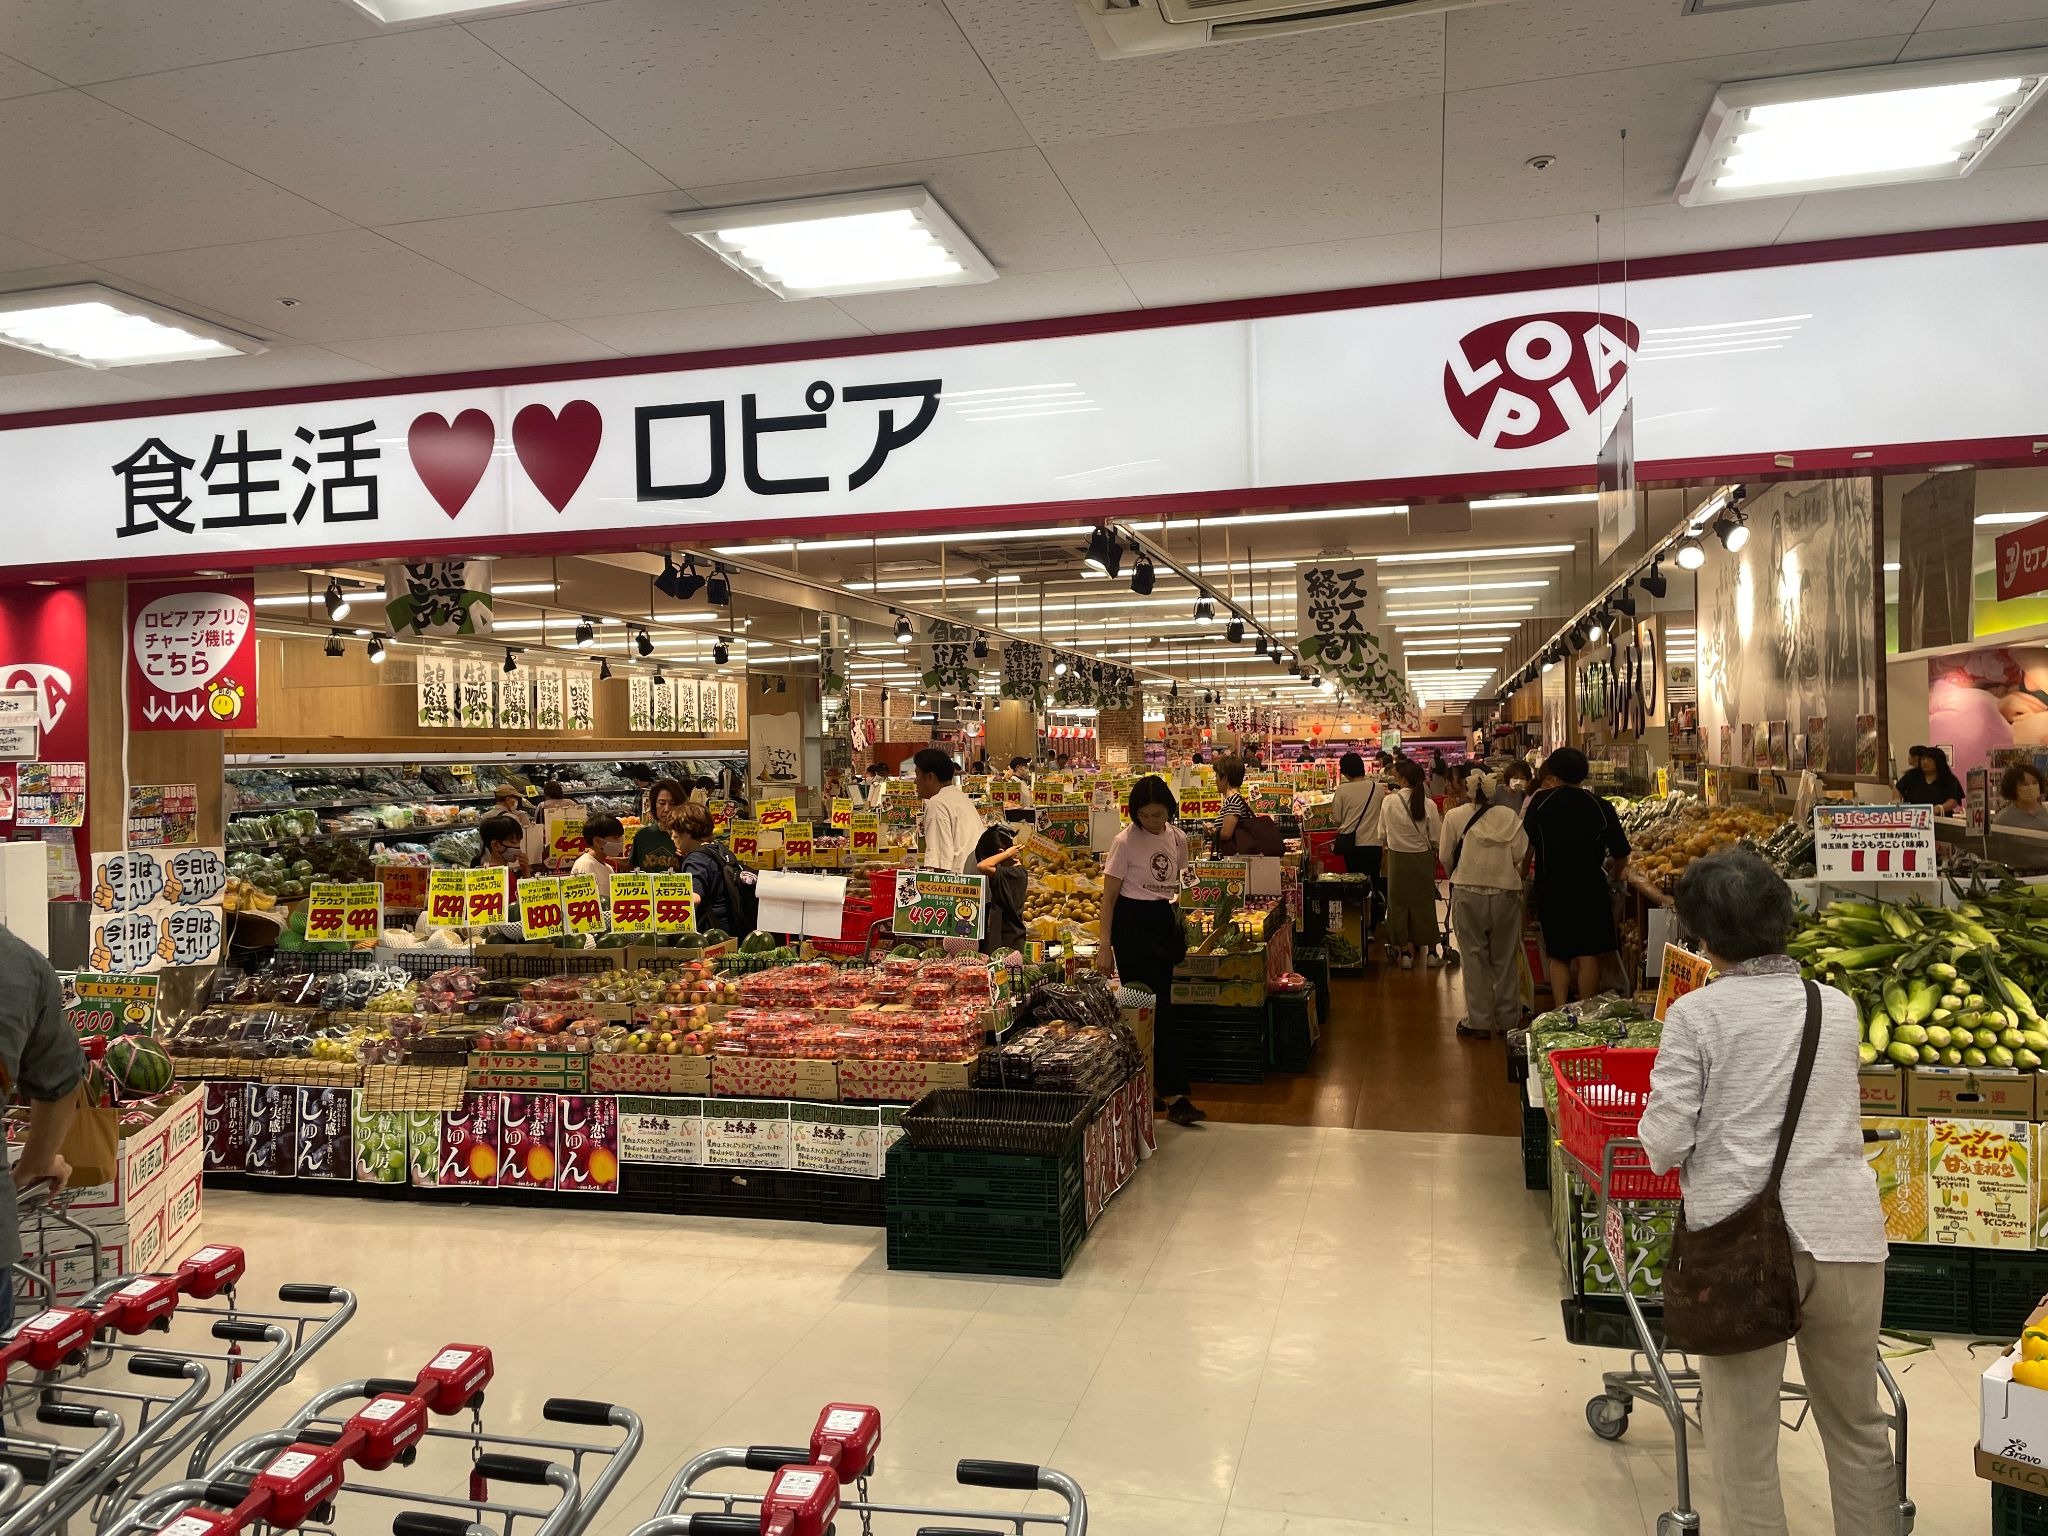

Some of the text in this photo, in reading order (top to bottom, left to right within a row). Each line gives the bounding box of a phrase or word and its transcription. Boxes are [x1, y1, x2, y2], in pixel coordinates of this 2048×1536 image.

[113, 379, 943, 538] 食生活 ロピア
[145, 609, 235, 628] ロピアアプリ
[145, 629, 234, 648] チャージ機は
[146, 651, 209, 675] こちら
[1835, 811, 1912, 825] BIG SALE
[175, 858, 216, 875] 今日は
[564, 889, 595, 899] ネクタリン
[615, 888, 648, 896] ソルダム
[1192, 887, 1221, 901] 399
[434, 895, 464, 917] 1299
[470, 893, 502, 917] 599
[568, 900, 600, 925] 599
[613, 900, 650, 923] 555
[657, 900, 690, 923] 555
[172, 918, 212, 934] 今日は
[310, 909, 344, 930] 555
[347, 908, 377, 931] 999
[528, 904, 561, 929] 1800
[909, 906, 948, 927] 499
[96, 976, 141, 984] 大玉サイズ!
[68, 1010, 115, 1032] 1800
[1936, 1125, 2004, 1145] ジューシー
[1961, 1144, 2013, 1161] 仕上げ
[2000, 1444, 2041, 1466] Bravo
